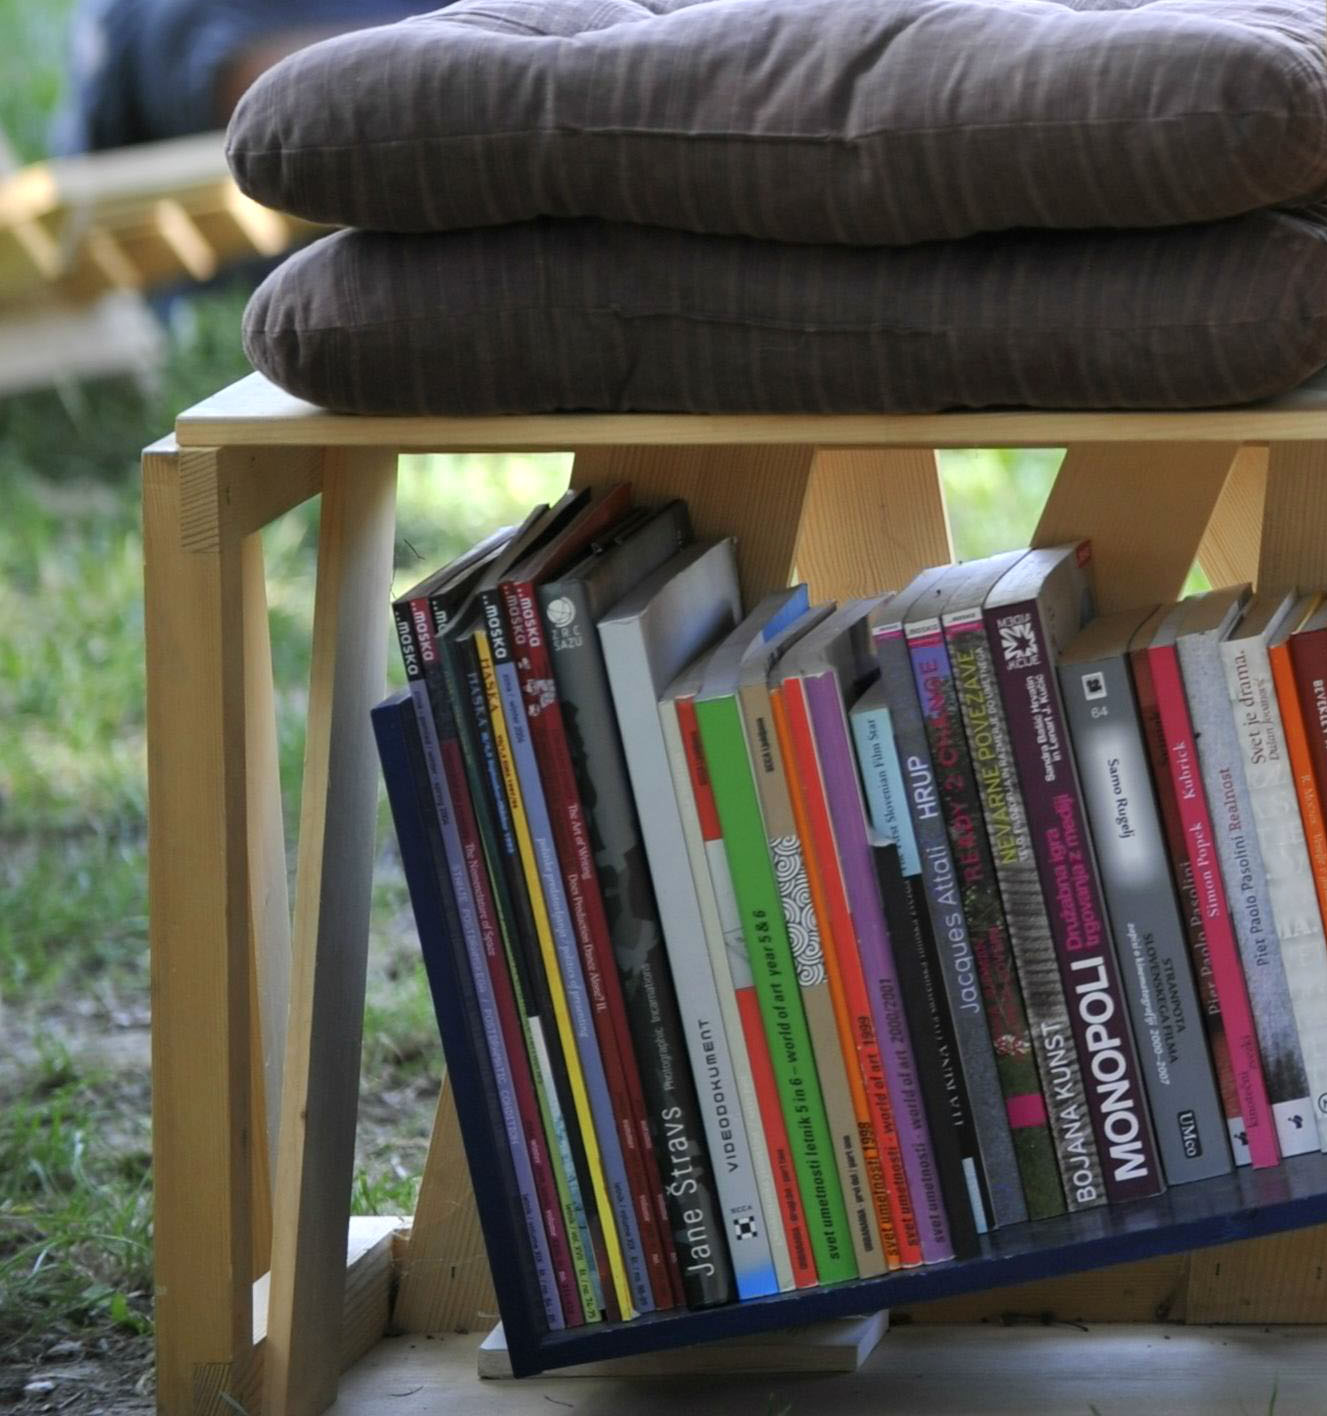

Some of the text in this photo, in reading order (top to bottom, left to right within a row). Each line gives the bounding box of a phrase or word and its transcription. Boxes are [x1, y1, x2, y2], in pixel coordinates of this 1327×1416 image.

[1023, 674, 1057, 782] Sandra Bašić Hrvatin
[1228, 648, 1267, 765] Svet je drama.
[906, 753, 981, 1015] Jacques Attali HRUP
[1051, 792, 1082, 848] mediji
[1106, 757, 1135, 840] Samo Rugelj
[1171, 739, 1221, 917] Simon Popek Kubrick
[1216, 766, 1271, 966] Pier Paolo Pasolini Realnost
[955, 647, 1098, 1203] BOJANA KUNST NEVARNE POVEZAVE
[1042, 825, 1084, 951] Družabna igra
[1066, 860, 1104, 947] trgovanja
[638, 961, 716, 1279] Jane Štravs Photographic Incarnations
[696, 1016, 740, 1172] VIDEODOKUMENT
[752, 908, 841, 1260] svet umetnosti letnik 5 in 6 world of art year 5 & 6
[878, 976, 946, 1243] svet umetnosti world of art 2000/2001
[1069, 955, 1150, 1182] MONOPOLI
